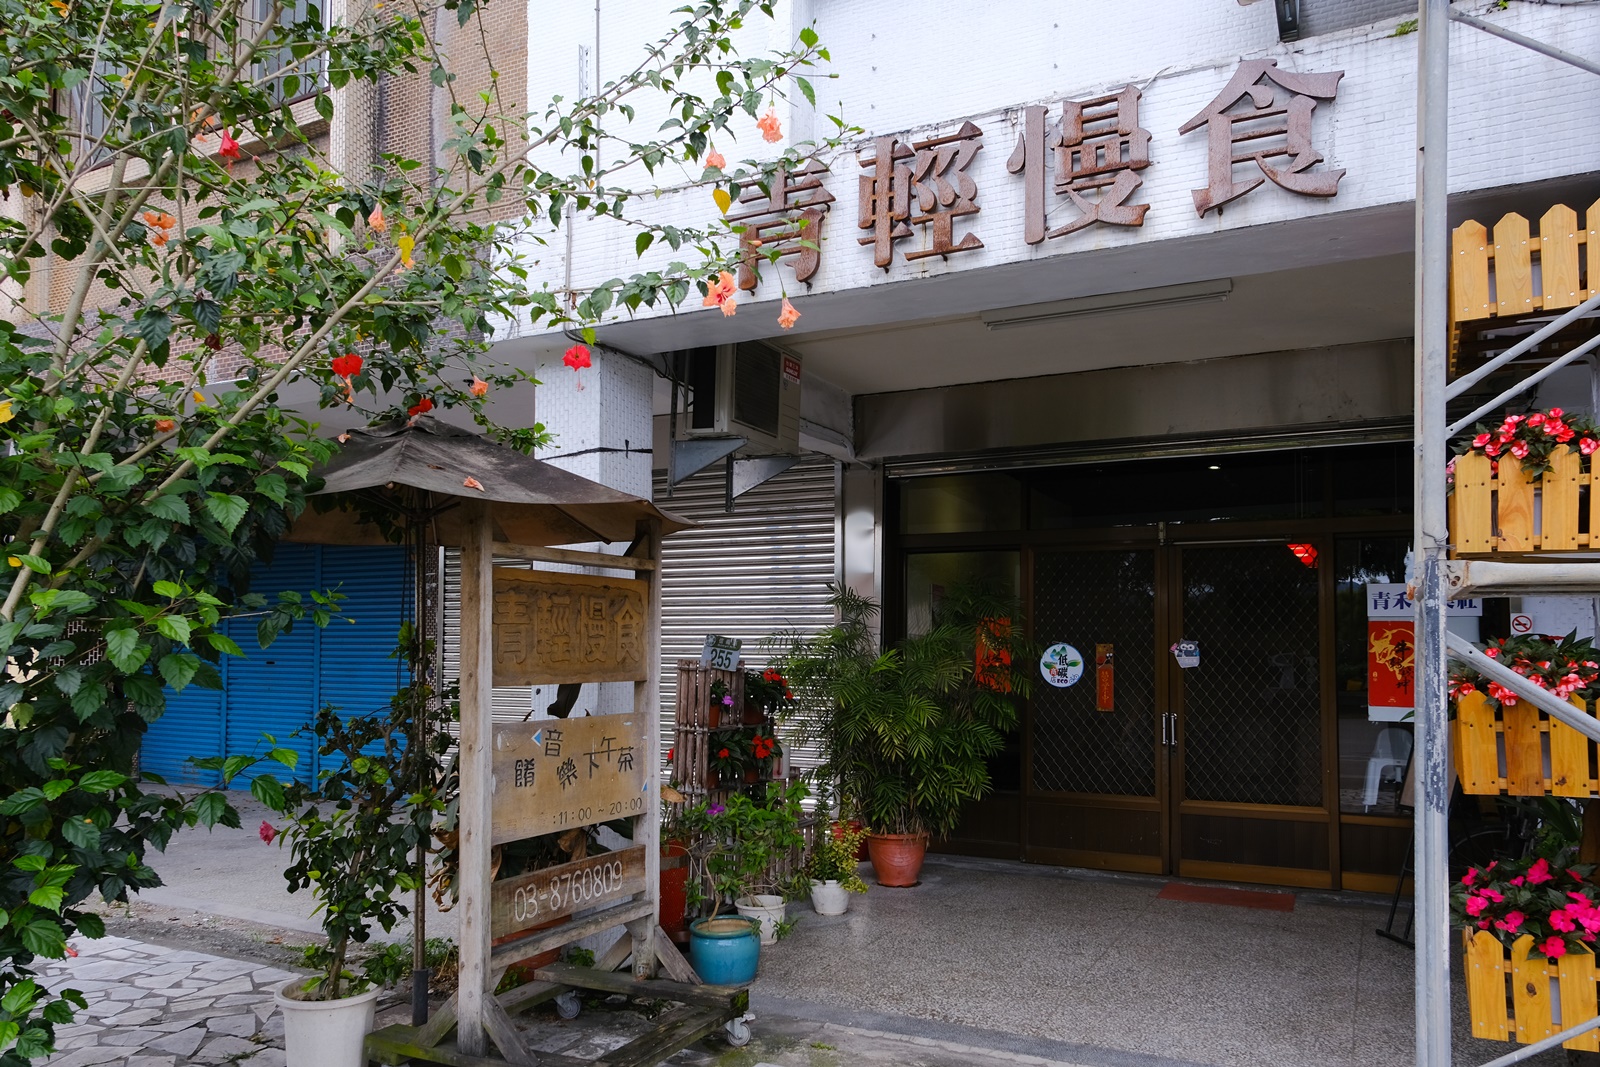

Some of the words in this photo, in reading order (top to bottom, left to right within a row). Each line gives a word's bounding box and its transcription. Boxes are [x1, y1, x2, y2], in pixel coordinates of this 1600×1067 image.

[724, 58, 1347, 292] 青輕慢食
[1371, 591, 1478, 610] 青禾社
[710, 648, 733, 669] 255
[1058, 654, 1068, 678] 低碳
[609, 797, 643, 815] 20:00
[514, 860, 623, 922] 03-8760809
